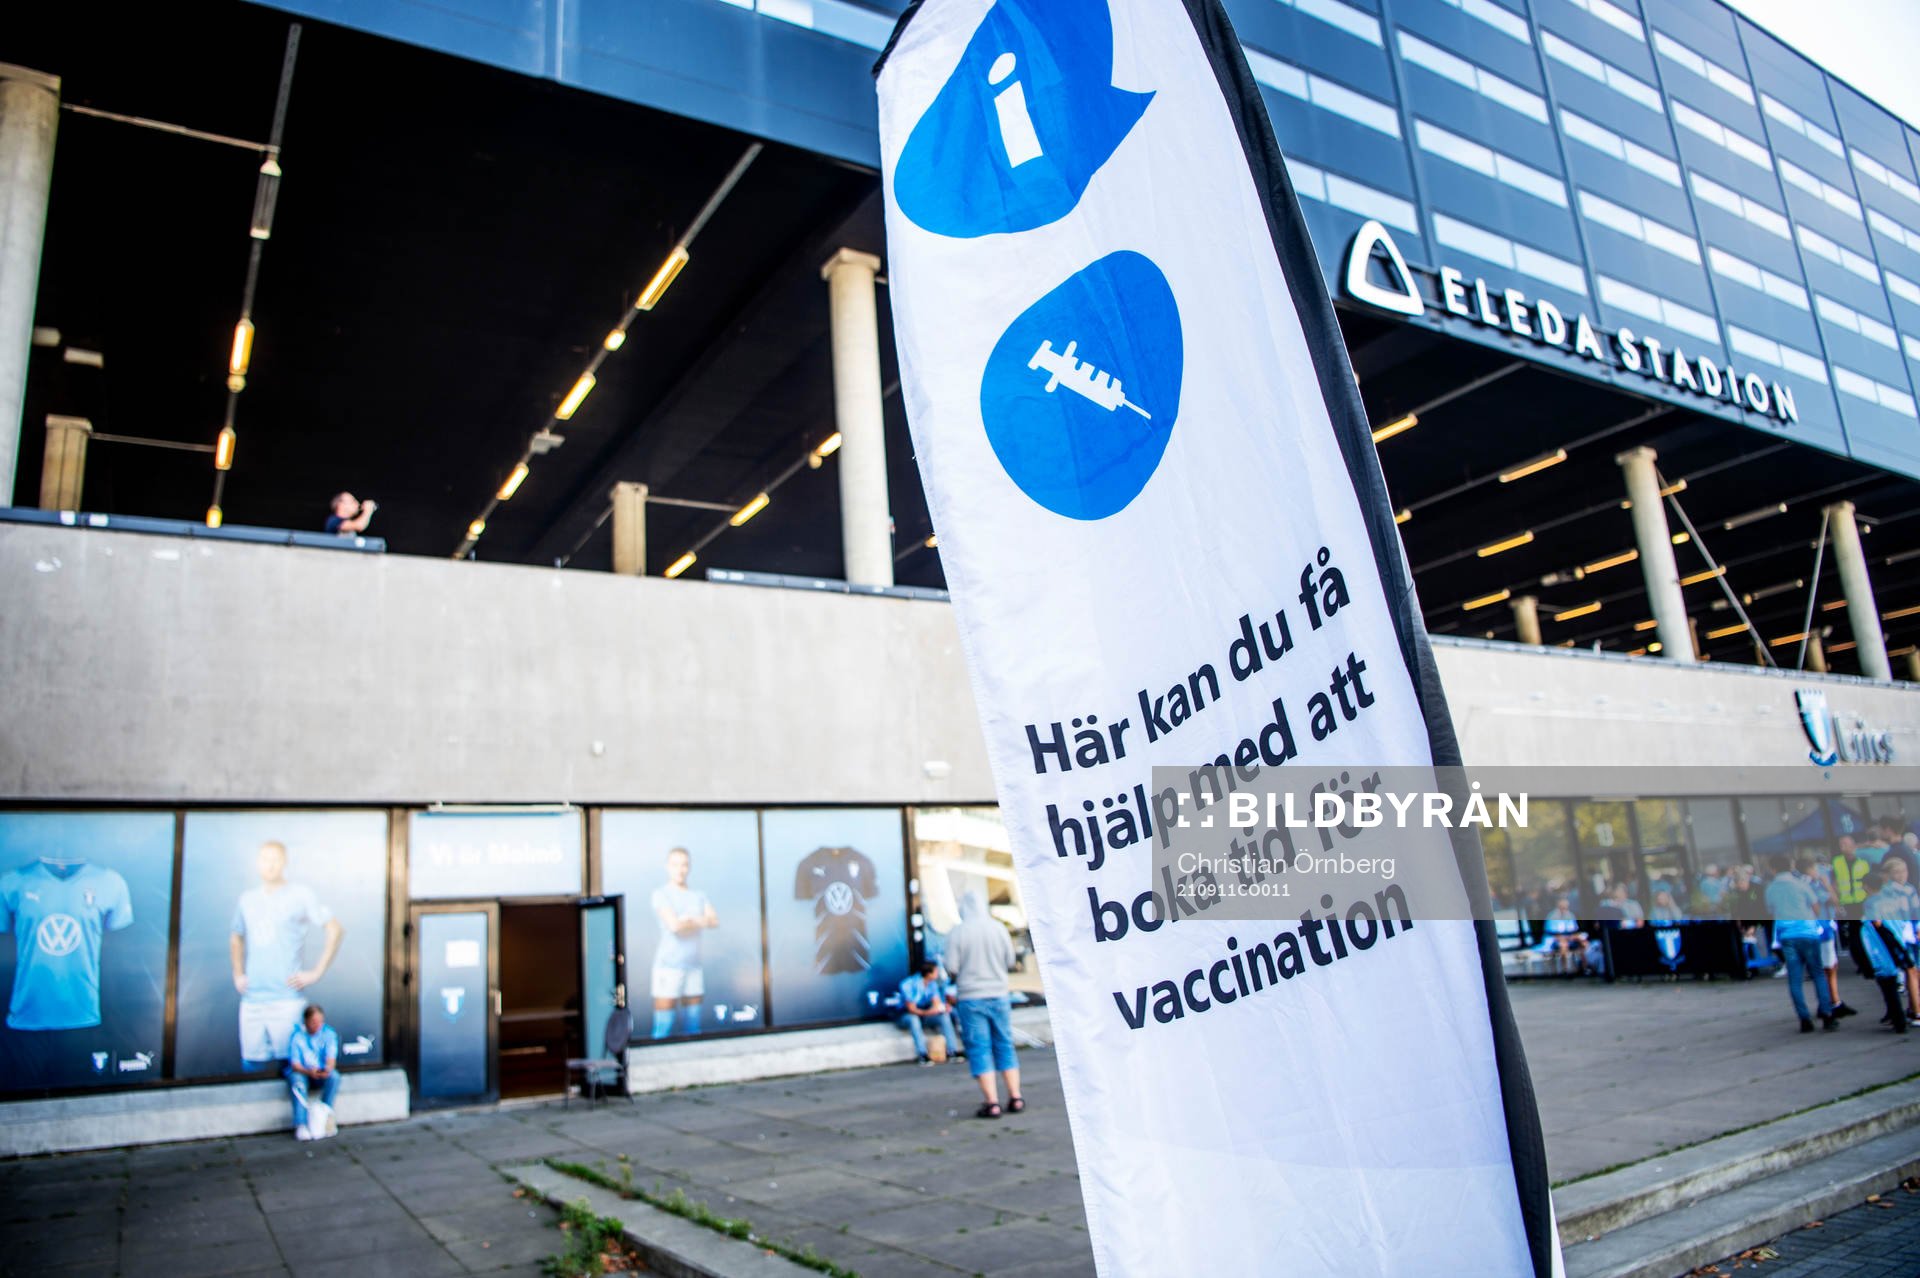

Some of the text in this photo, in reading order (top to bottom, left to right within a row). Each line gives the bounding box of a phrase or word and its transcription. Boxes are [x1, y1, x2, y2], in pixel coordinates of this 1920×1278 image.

[1441, 267, 1798, 423] ELEDA STADION
[1025, 546, 1351, 774] Här kan du få
[1046, 651, 1375, 871] hjälp med att
[1087, 771, 1382, 942] boka tid för
[1112, 883, 1414, 1030] vaccination
